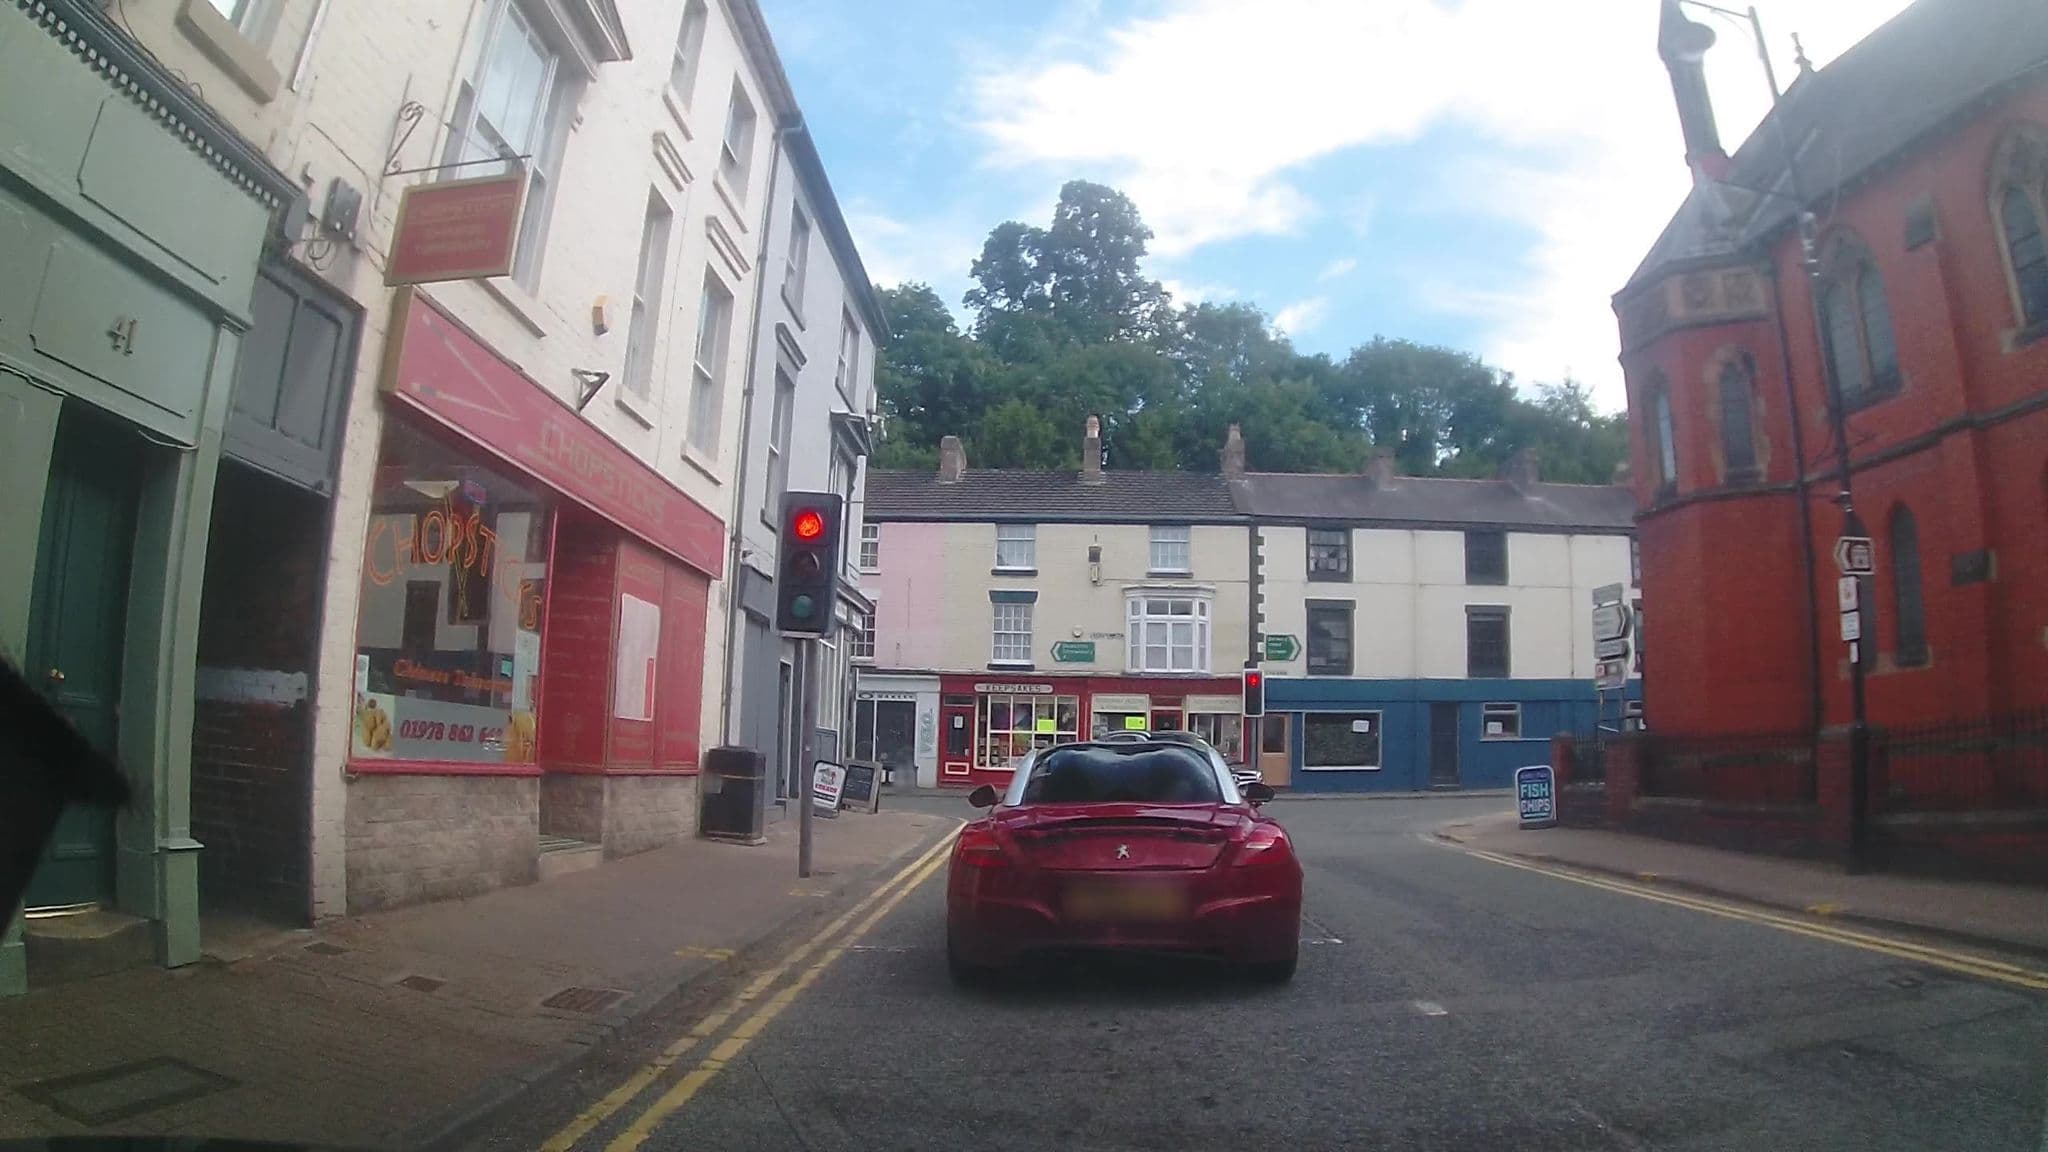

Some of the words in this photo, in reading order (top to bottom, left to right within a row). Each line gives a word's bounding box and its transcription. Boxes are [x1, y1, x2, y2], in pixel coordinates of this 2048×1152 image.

[108, 315, 138, 356] 41
[541, 420, 666, 524] CHOPSTICKS
[985, 683, 1041, 693] KEEPSAKES
[1520, 783, 1549, 798] FISH
[1520, 798, 1551, 813] CHIPS
